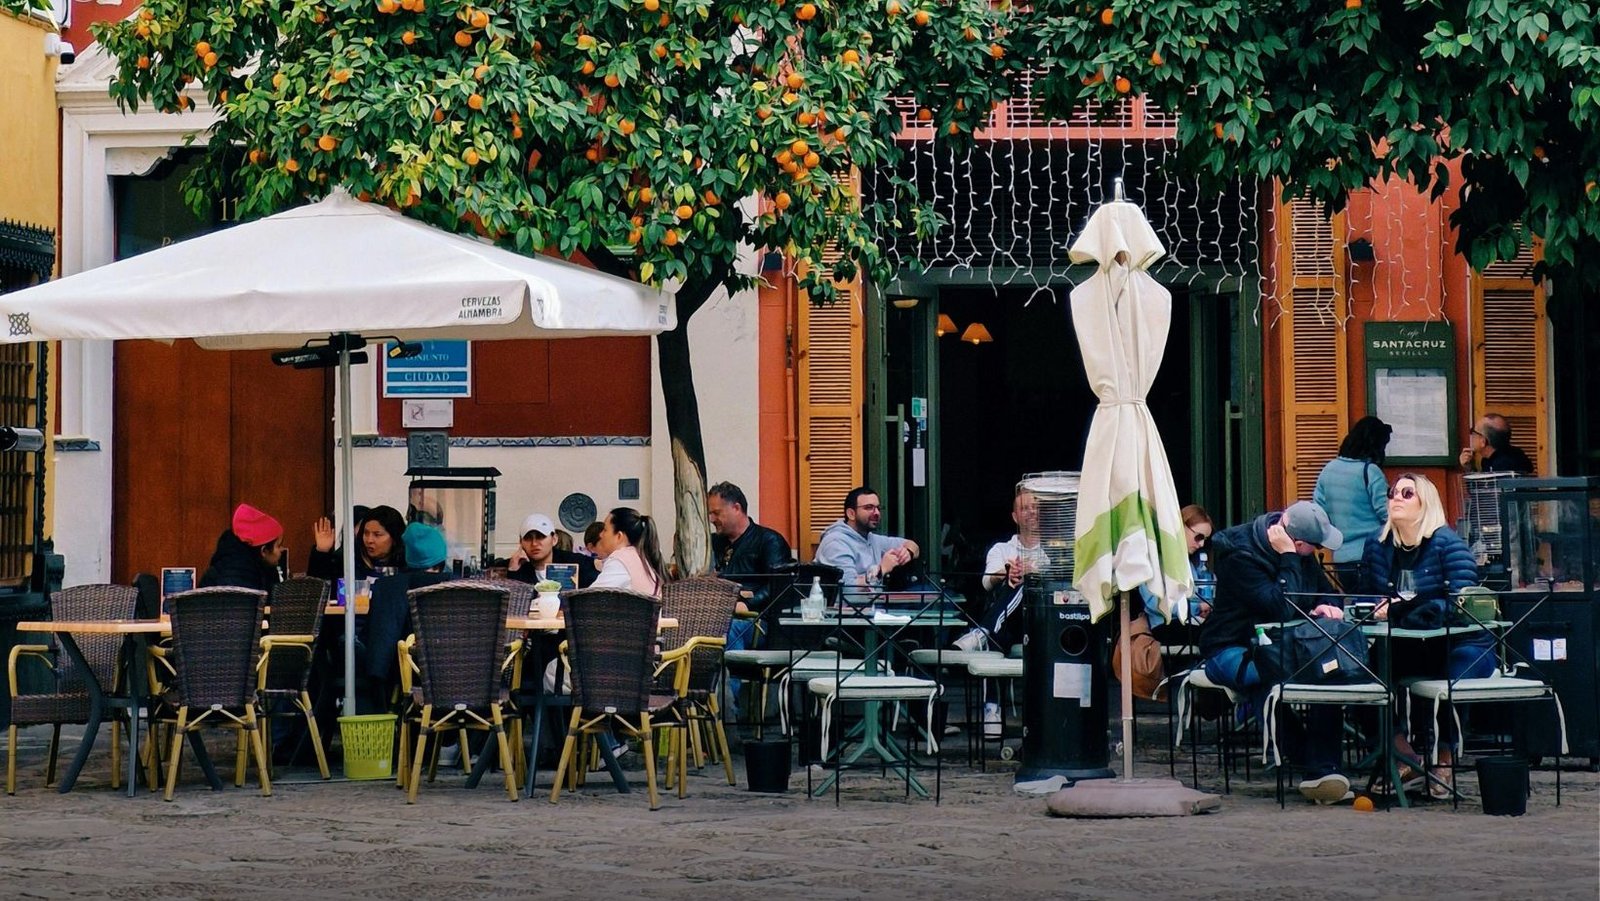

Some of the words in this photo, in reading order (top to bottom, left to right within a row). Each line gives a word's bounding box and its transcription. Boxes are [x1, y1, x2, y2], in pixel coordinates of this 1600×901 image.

[461, 296, 501, 307] CERVEZAS
[458, 308, 502, 319] ALHAMBRA
[1373, 340, 1446, 348] SANTACRUZ
[404, 372, 450, 381] CIUDAD
